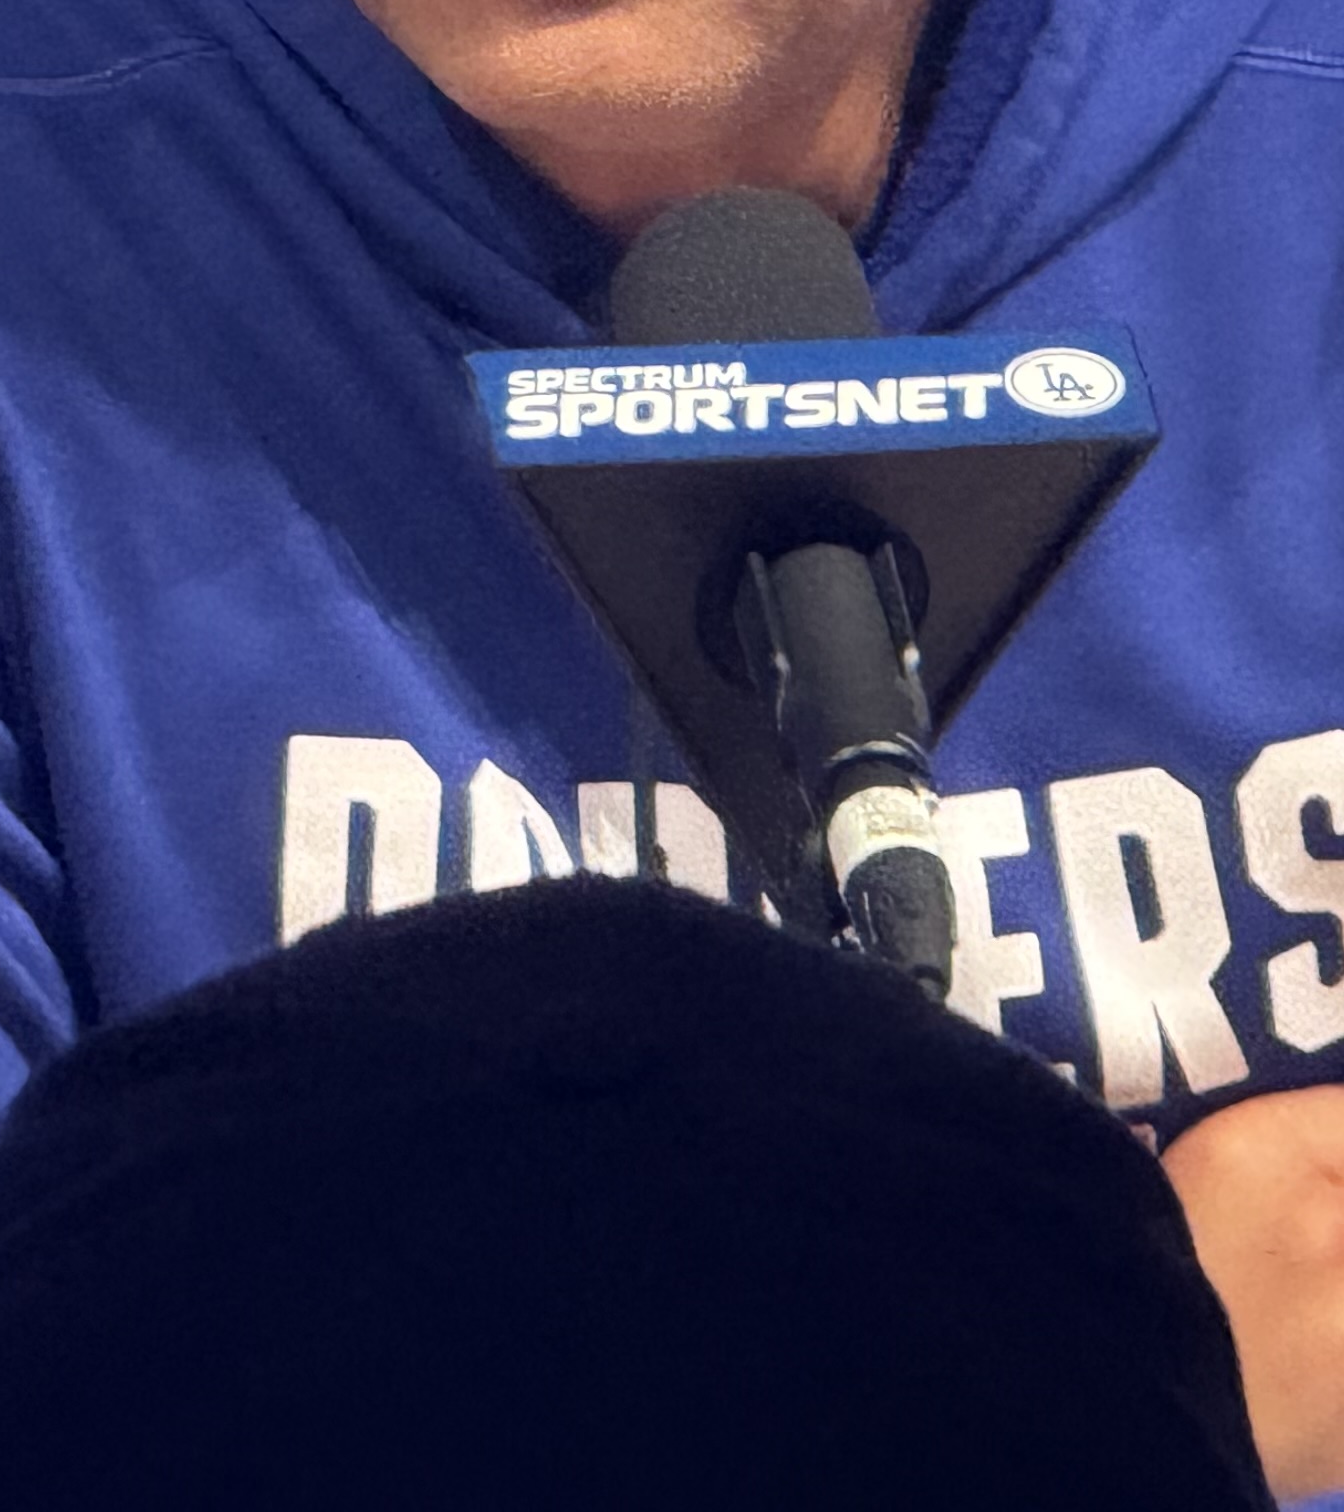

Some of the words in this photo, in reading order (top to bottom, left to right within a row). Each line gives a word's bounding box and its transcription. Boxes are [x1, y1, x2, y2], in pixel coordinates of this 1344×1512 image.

[507, 361, 748, 395] SPECTRUM
[1035, 363, 1096, 402] LA
[505, 372, 1005, 440] SPORTSNET
